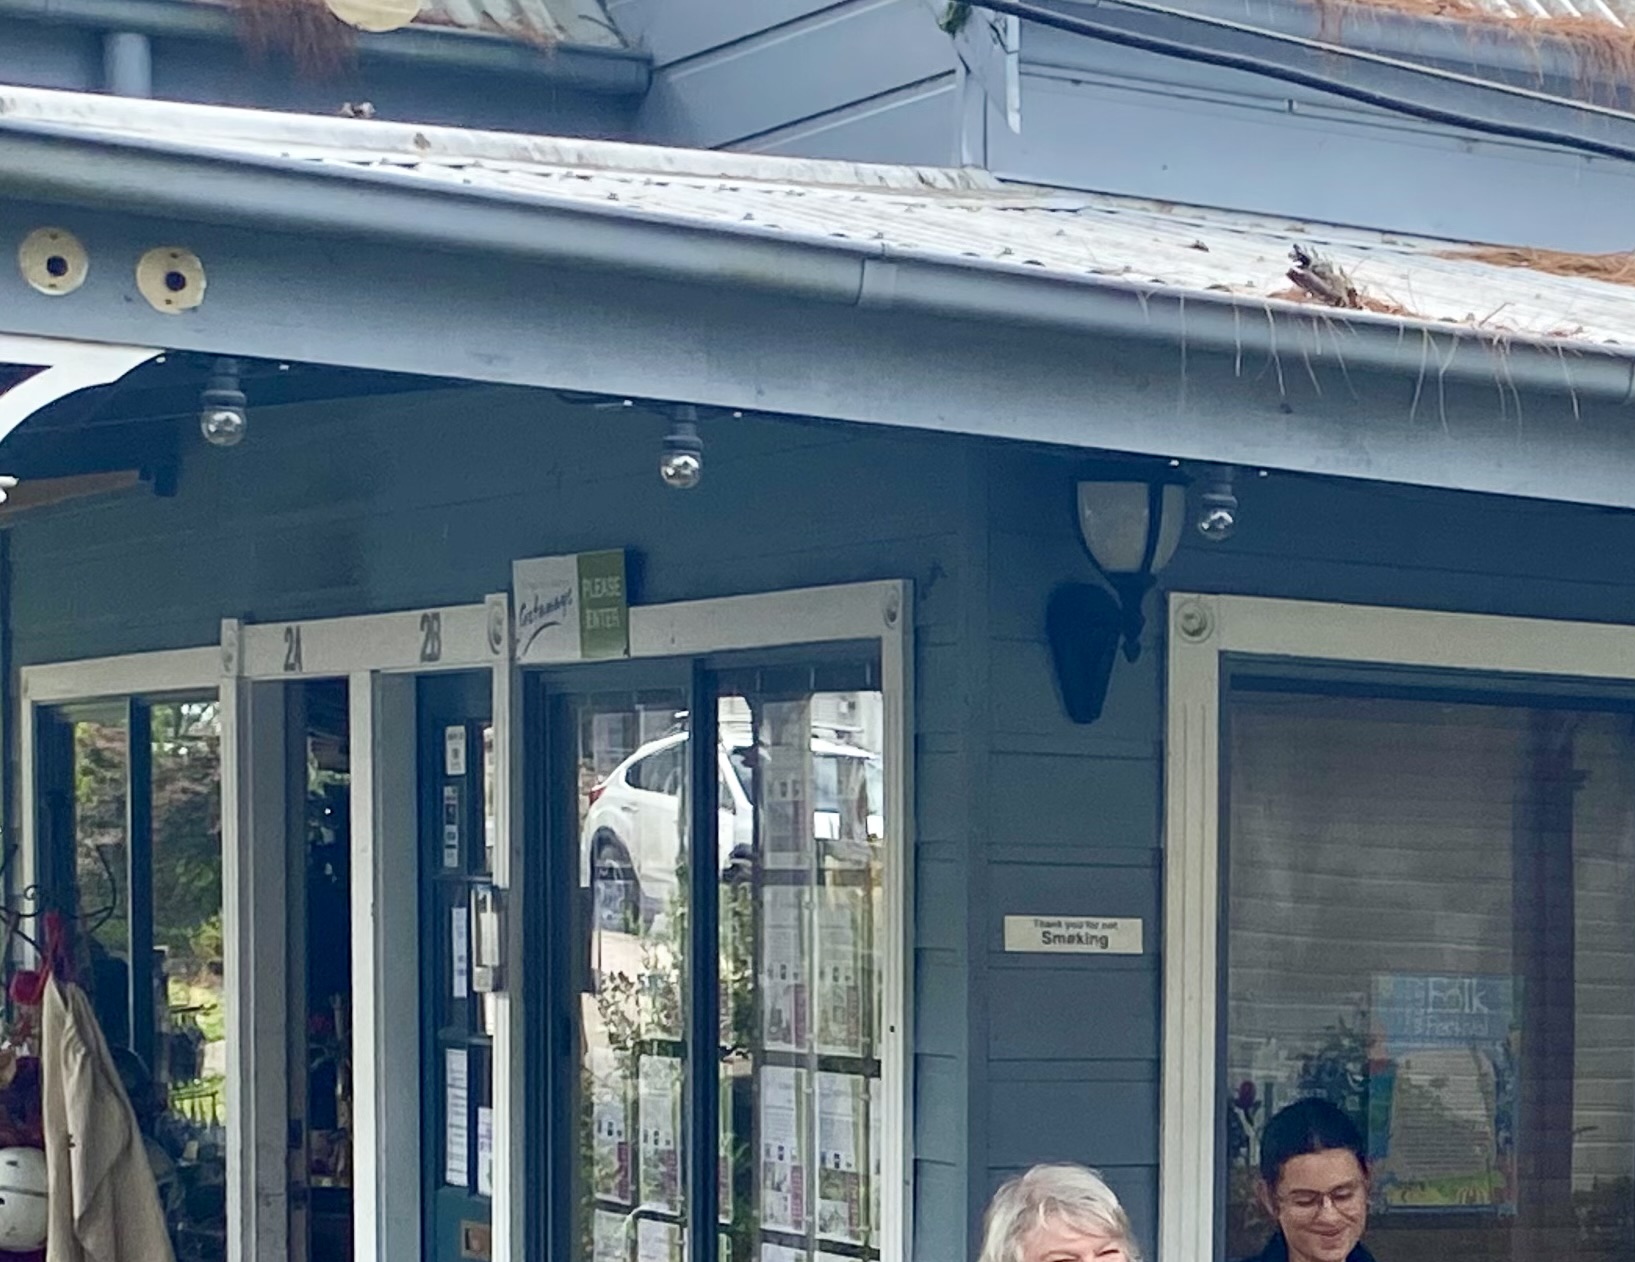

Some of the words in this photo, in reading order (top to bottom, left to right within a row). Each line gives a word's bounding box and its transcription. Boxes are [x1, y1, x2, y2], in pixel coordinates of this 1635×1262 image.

[582, 576, 621, 599] PLEASE
[585, 607, 620, 629] ENTER
[420, 612, 442, 663] 2B
[1033, 918, 1062, 929] Thank
[1065, 920, 1083, 931] you
[1086, 920, 1099, 930] for
[1041, 930, 1109, 949] Smoking
[1427, 976, 1489, 1014] Folk
